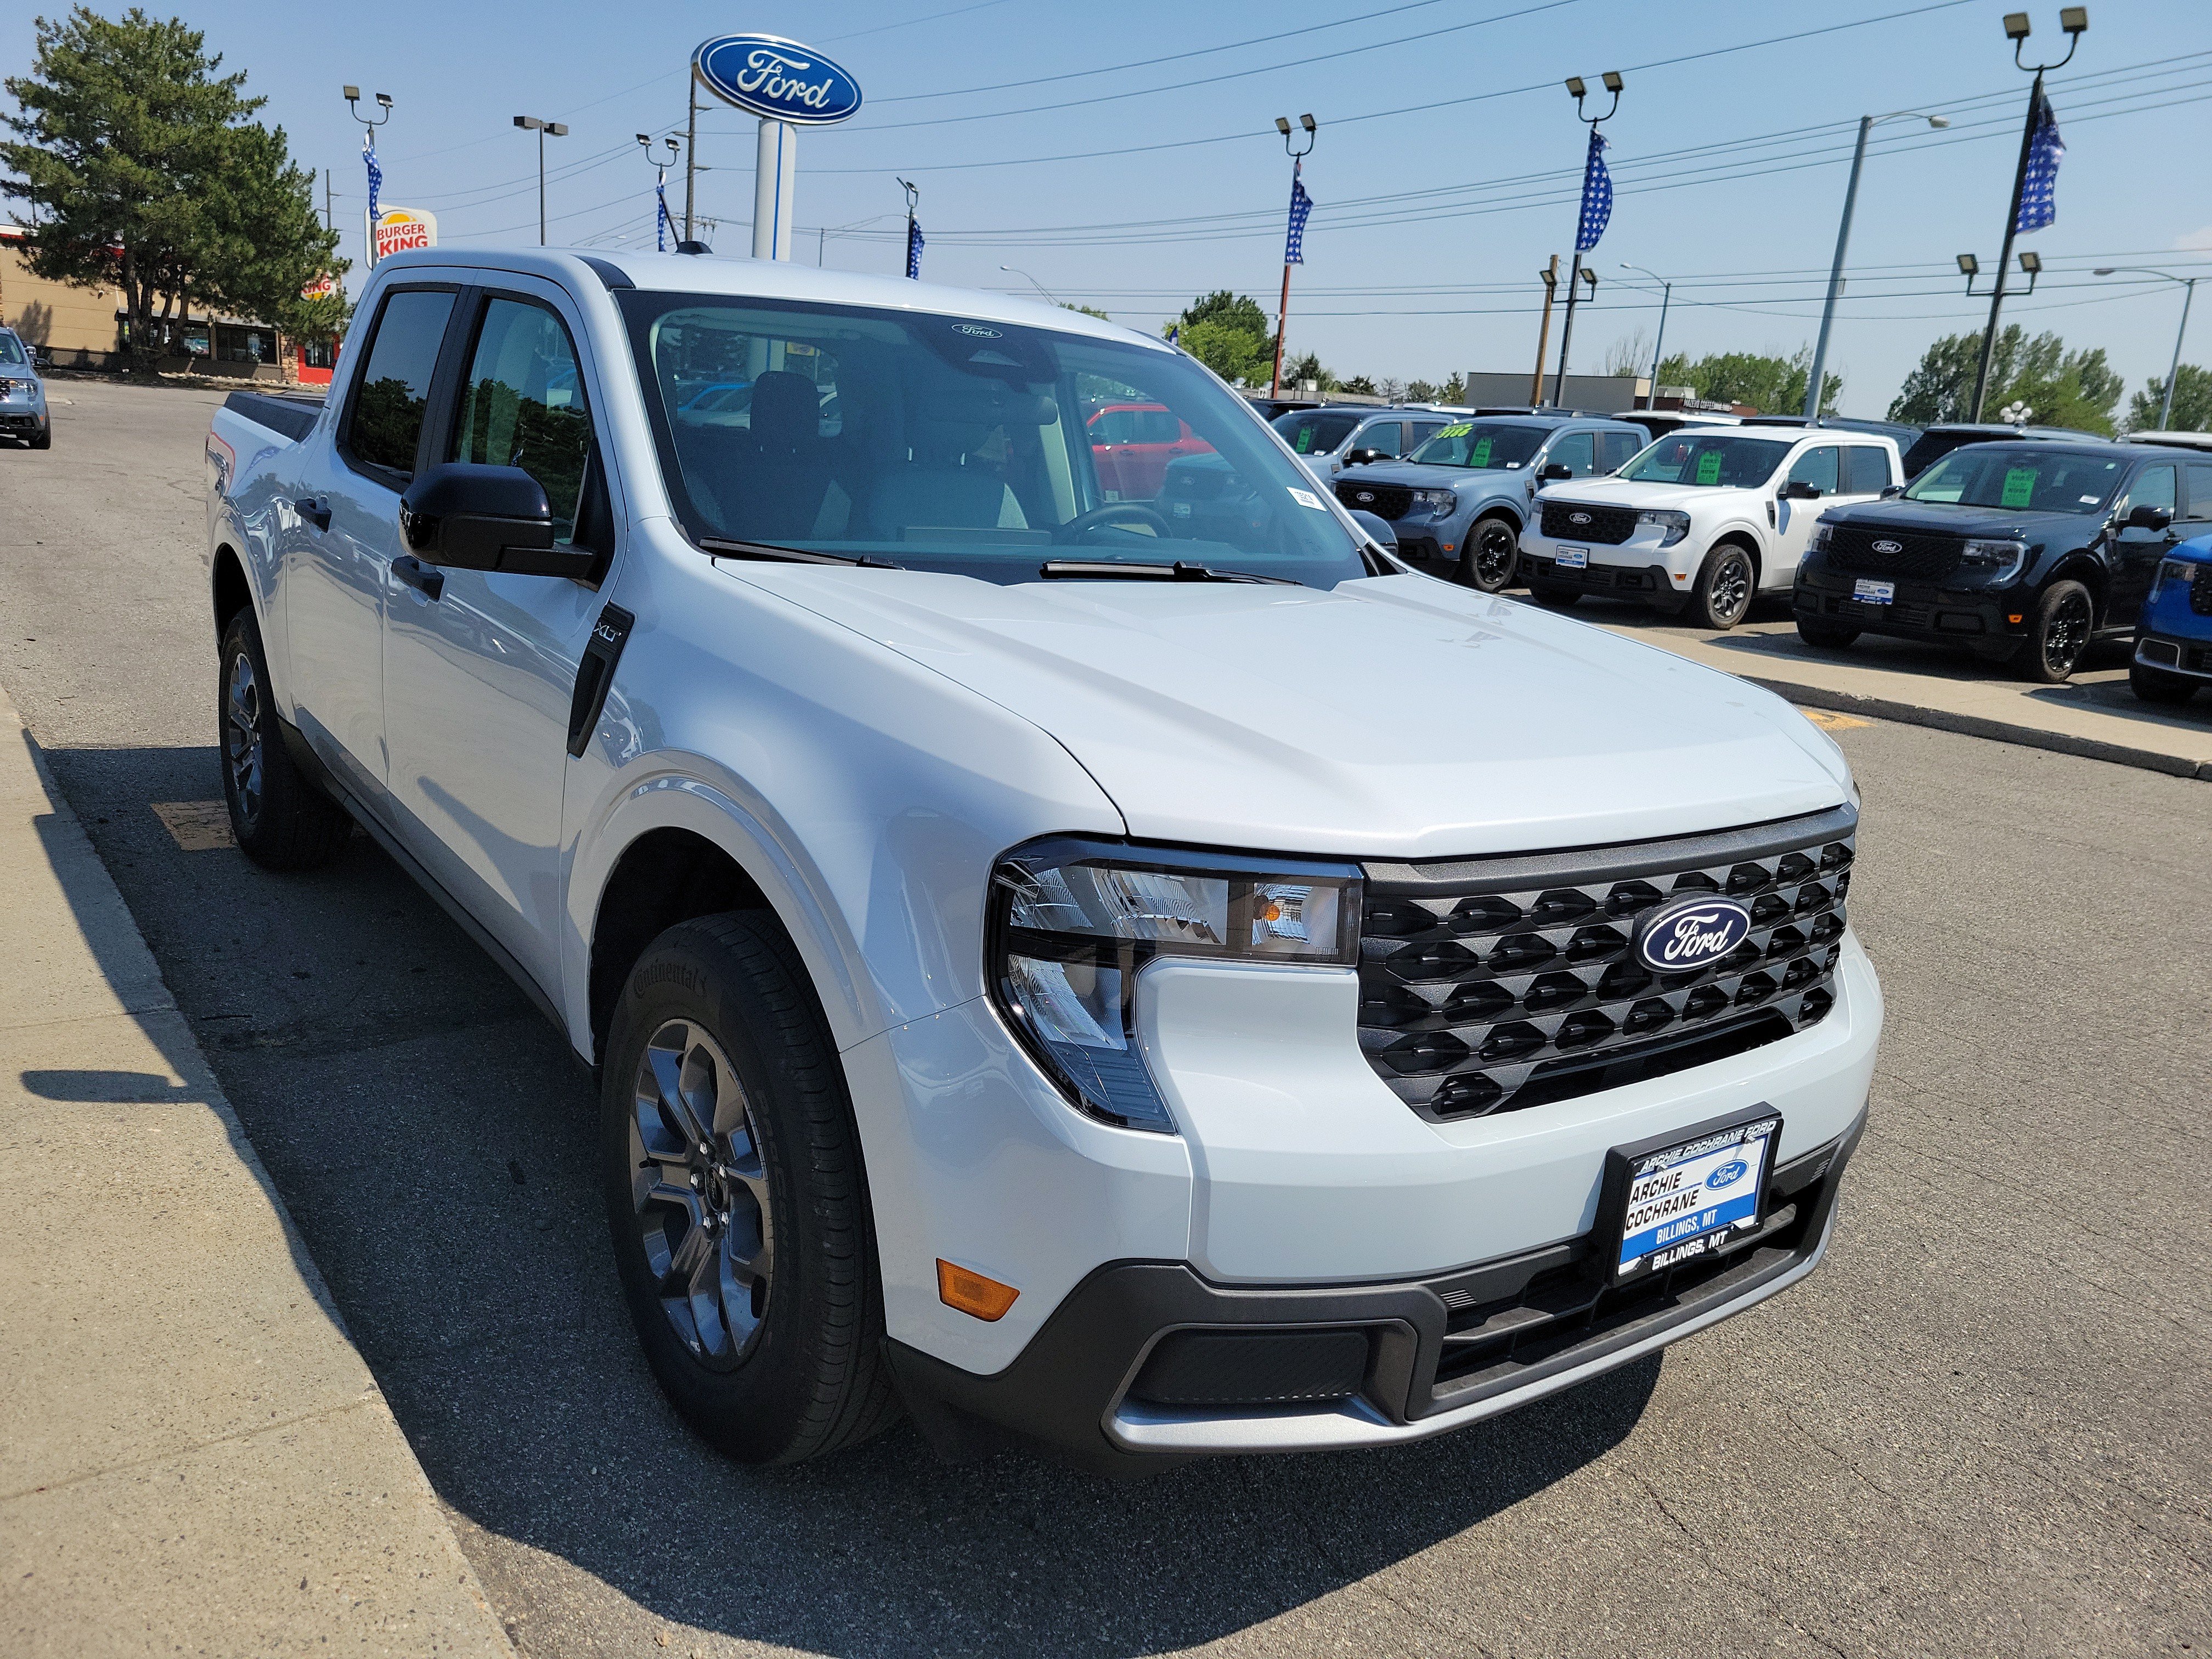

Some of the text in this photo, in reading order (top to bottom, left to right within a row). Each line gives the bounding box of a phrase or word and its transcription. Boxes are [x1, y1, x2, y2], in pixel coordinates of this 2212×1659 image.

[737, 50, 834, 109] Ford
[377, 224, 426, 240] BURGER
[379, 235, 428, 257] KING
[962, 325, 995, 336] Ford
[1877, 542, 1897, 552] Ford
[593, 622, 622, 642] XLT
[1664, 913, 1734, 961] Ford
[634, 962, 698, 998] Continental
[1640, 1121, 1777, 1172] ARCHIE COCHRANE FORD
[1630, 1171, 1683, 1205] ARCHIE
[1713, 1164, 1740, 1186] Ford
[1626, 1189, 1700, 1231] COCHRANE
[1656, 1209, 1718, 1245] BILLINGS, MT
[1652, 1231, 1728, 1271] BILLINGS, MT
